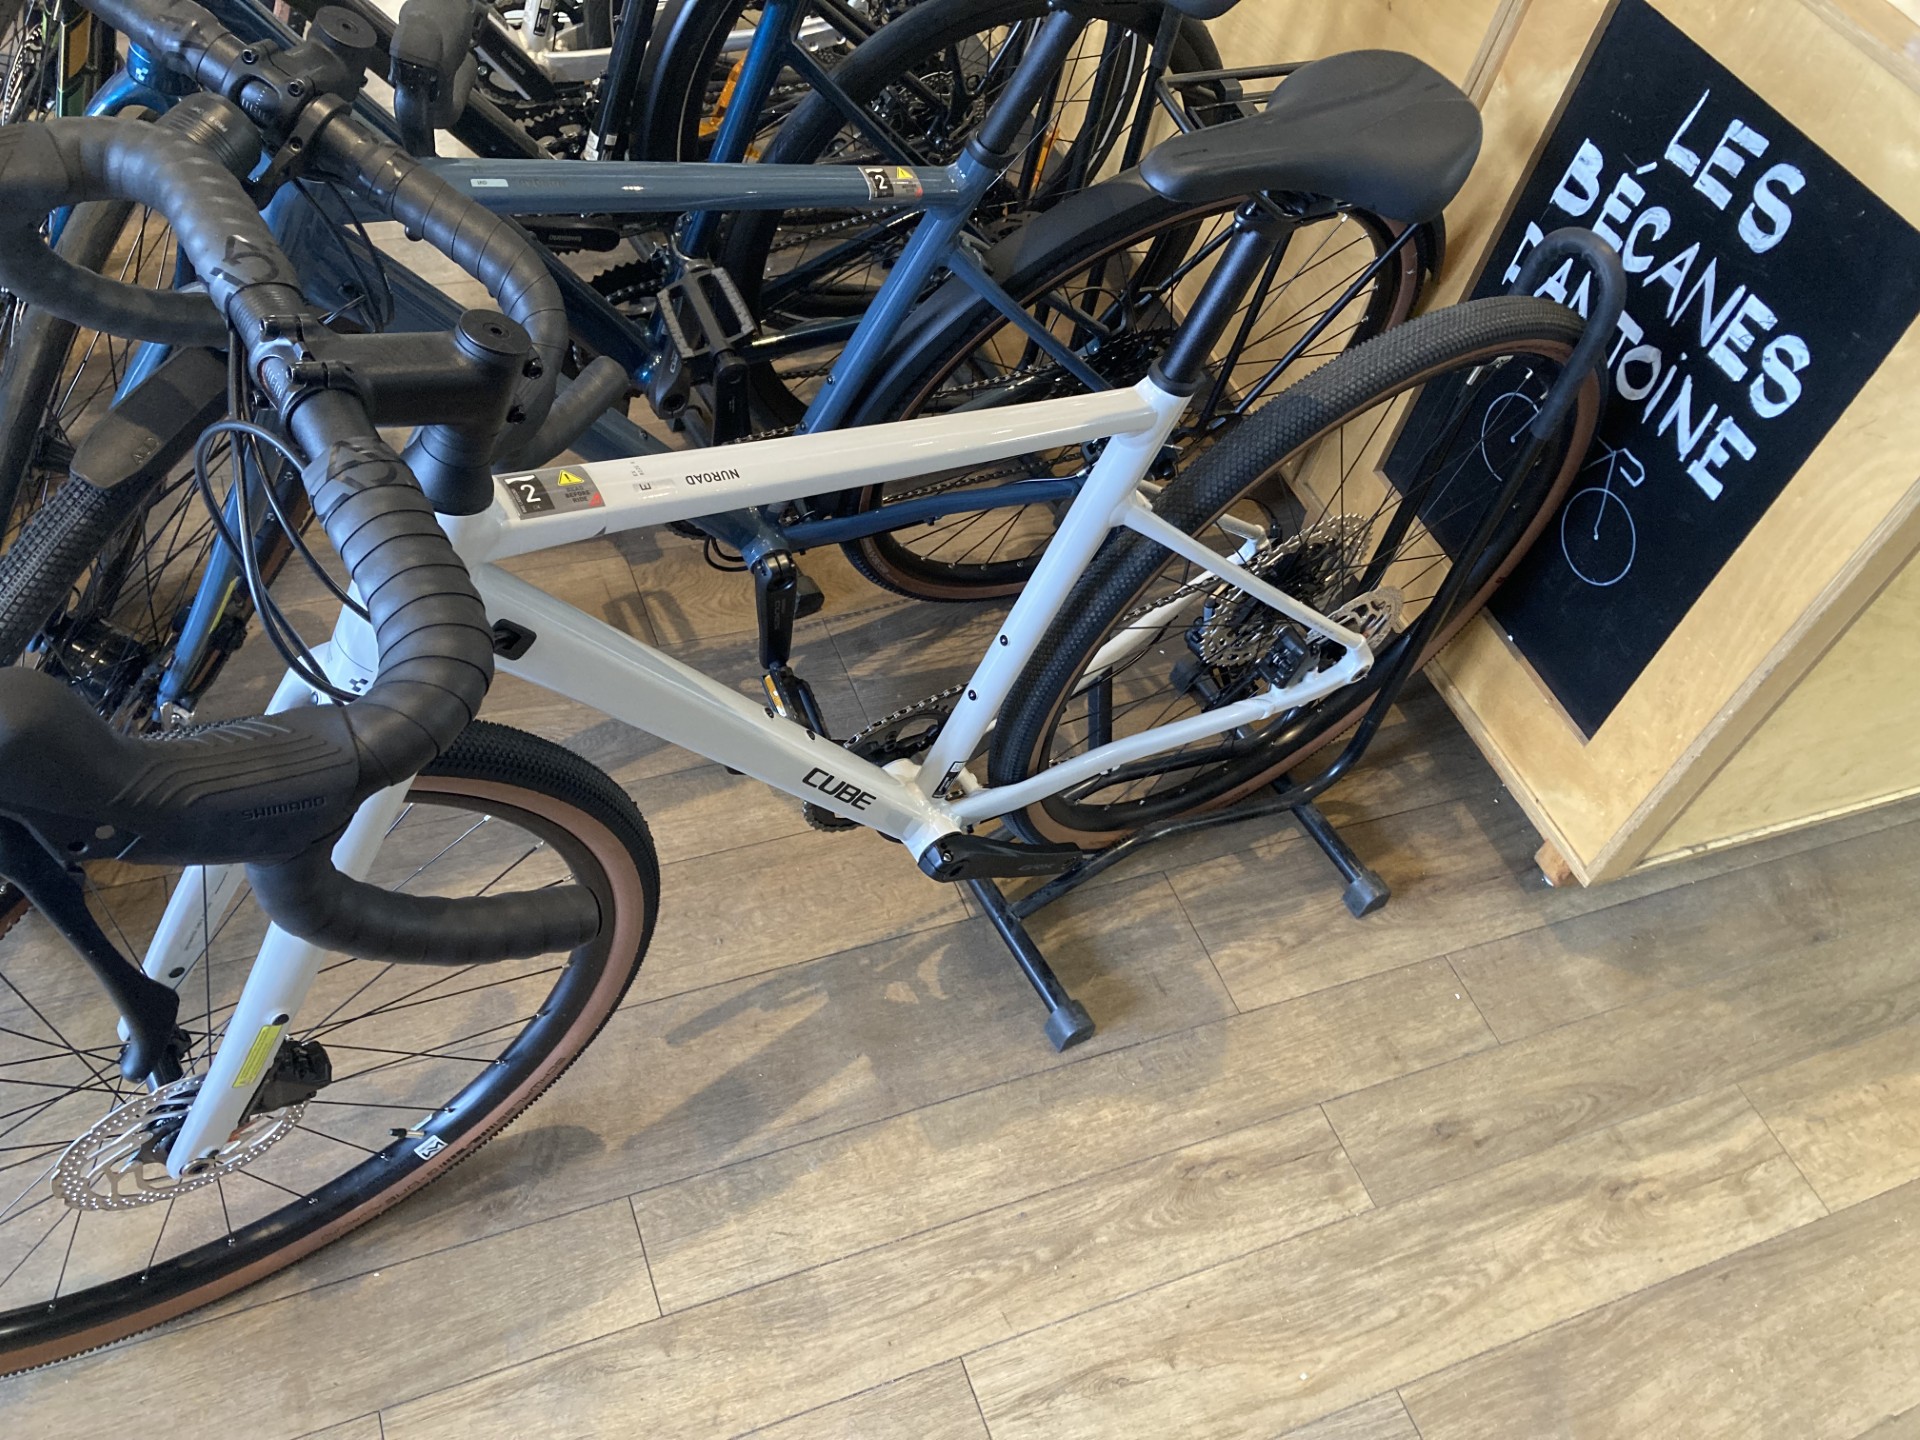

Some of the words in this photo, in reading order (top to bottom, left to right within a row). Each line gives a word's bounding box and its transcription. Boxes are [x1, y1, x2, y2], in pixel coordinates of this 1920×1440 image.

[875, 174, 889, 190] 2
[1664, 88, 1807, 254] LES
[1549, 137, 1812, 419] BÉCANES
[685, 468, 741, 486] NUROAD
[520, 484, 542, 503] 2
[802, 767, 877, 811] CUBE
[241, 796, 327, 821] SHIMANO
